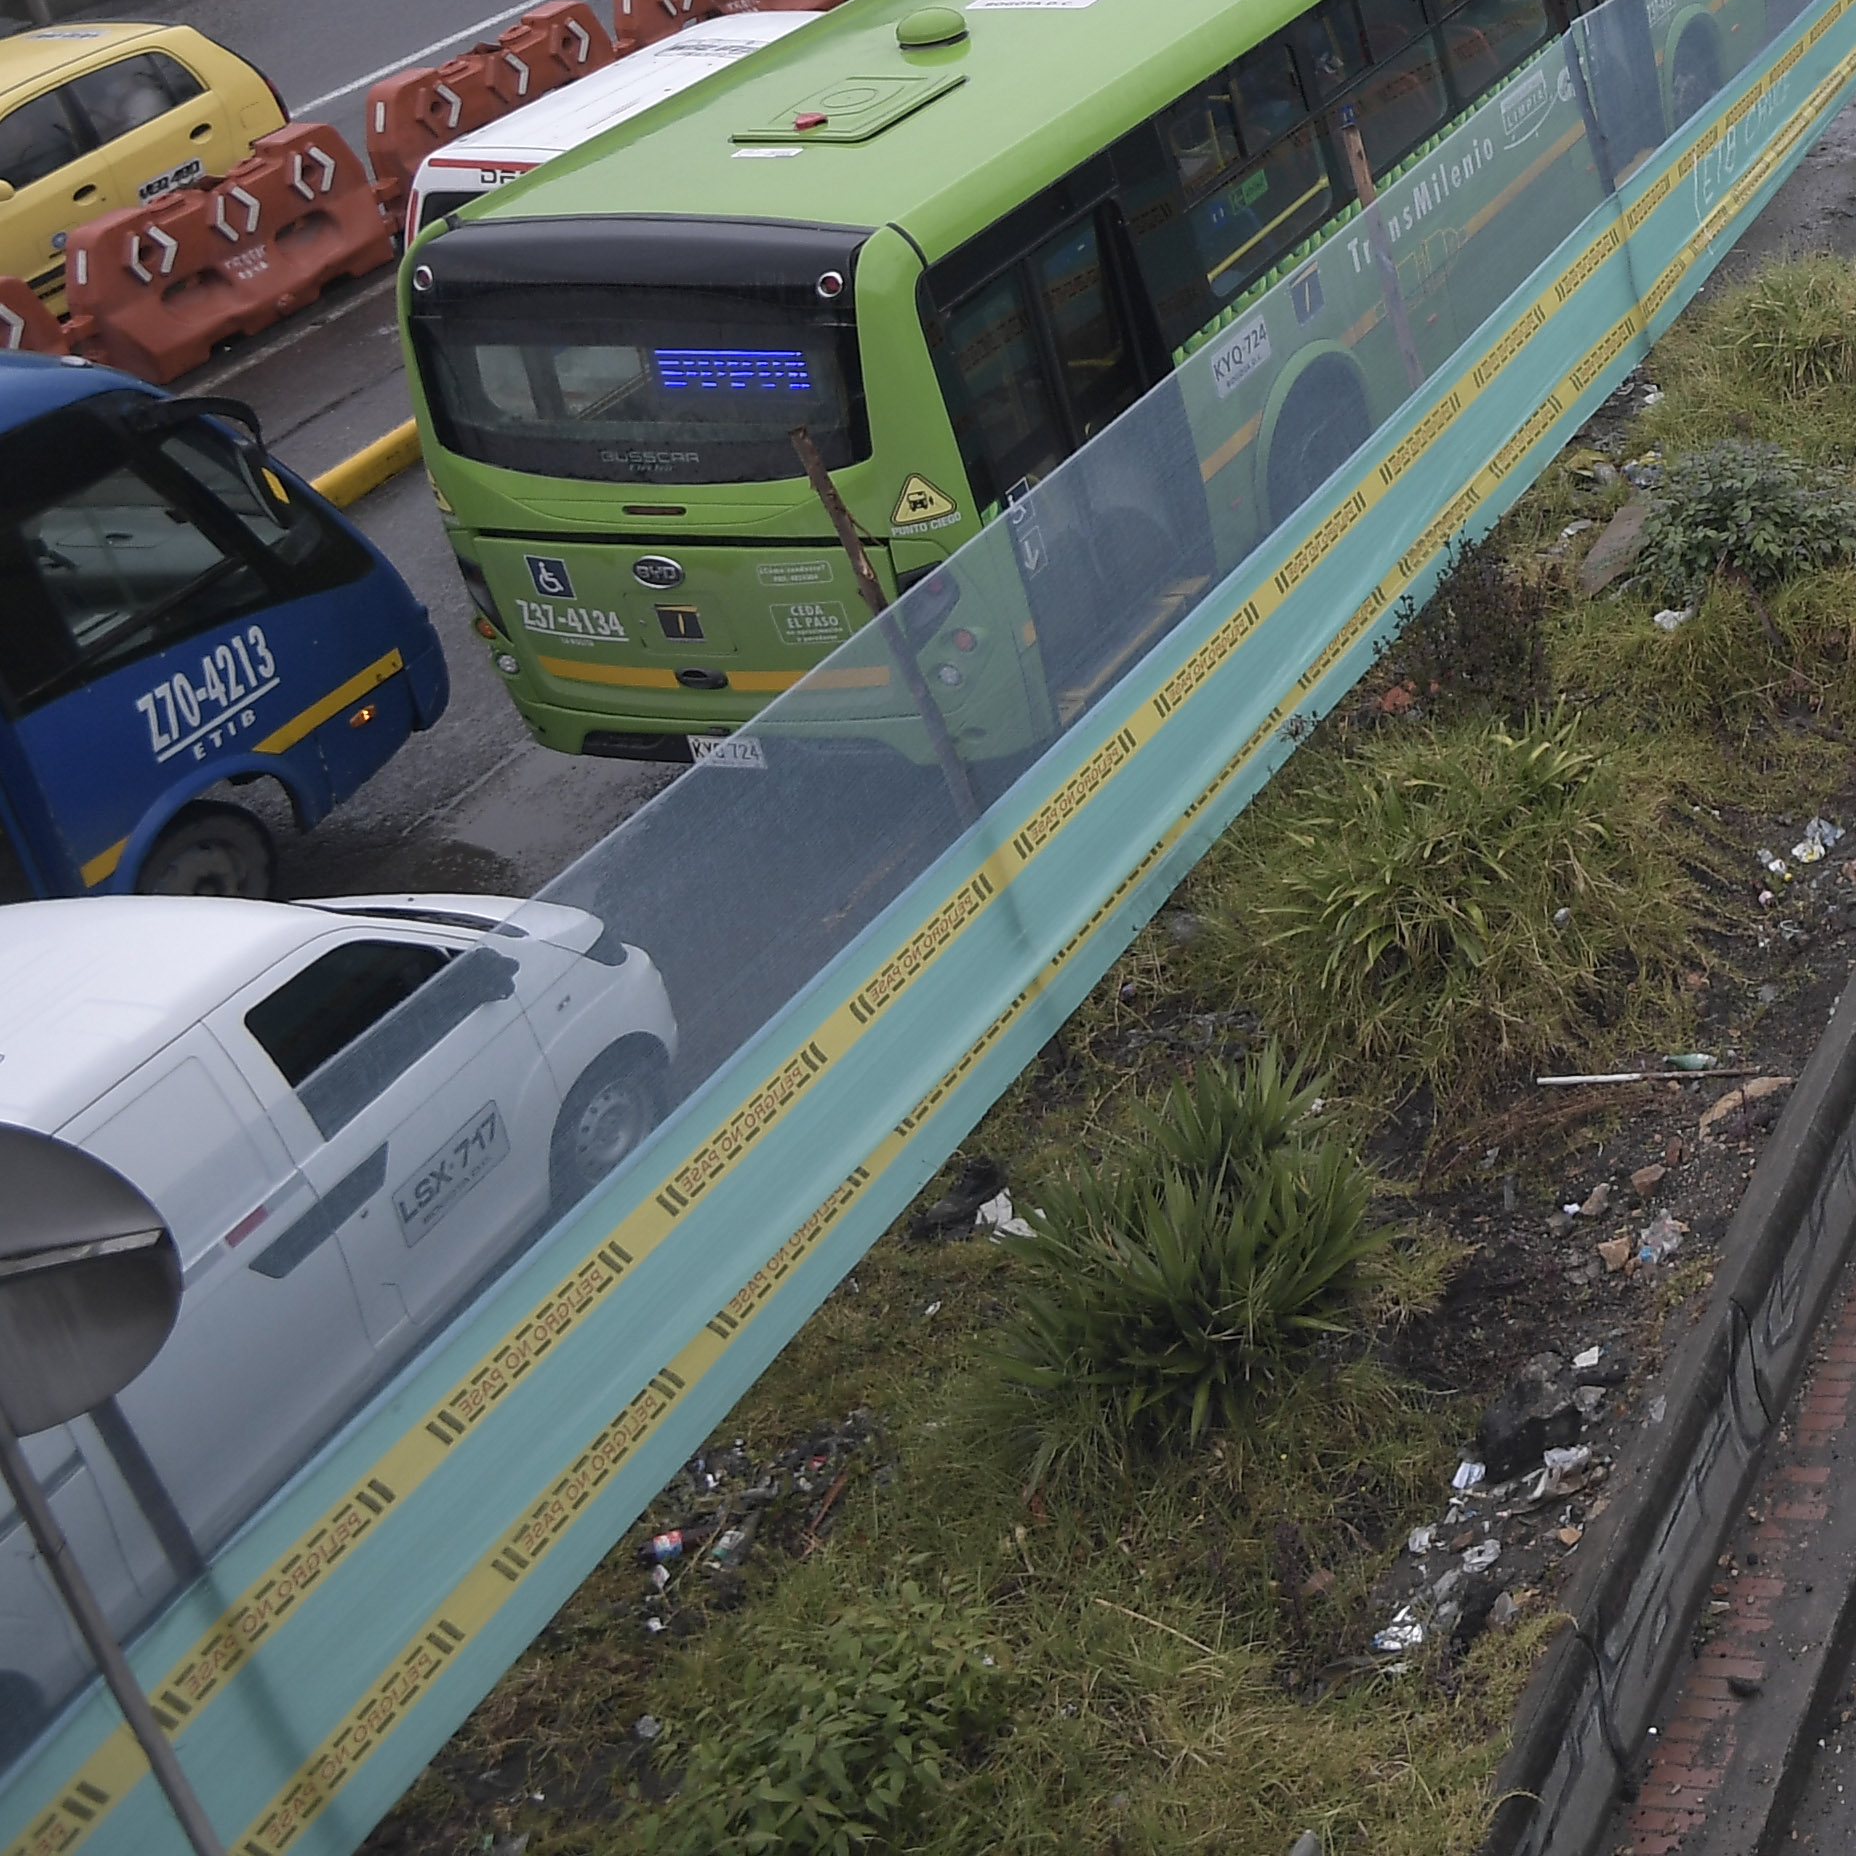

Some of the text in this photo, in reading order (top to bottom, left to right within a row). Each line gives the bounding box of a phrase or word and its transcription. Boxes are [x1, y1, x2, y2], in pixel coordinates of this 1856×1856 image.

[1347, 135, 1495, 275] TrnsMilenio
[602, 450, 700, 465] BUSSCAR
[636, 564, 677, 581] BYD
[516, 599, 625, 637] Z37-4134
[790, 605, 824, 617] CEDA
[786, 614, 839, 629] EL PASO
[136, 624, 276, 753] Z70-4213
[192, 709, 257, 761] ETIB
[728, 742, 761, 761] 724
